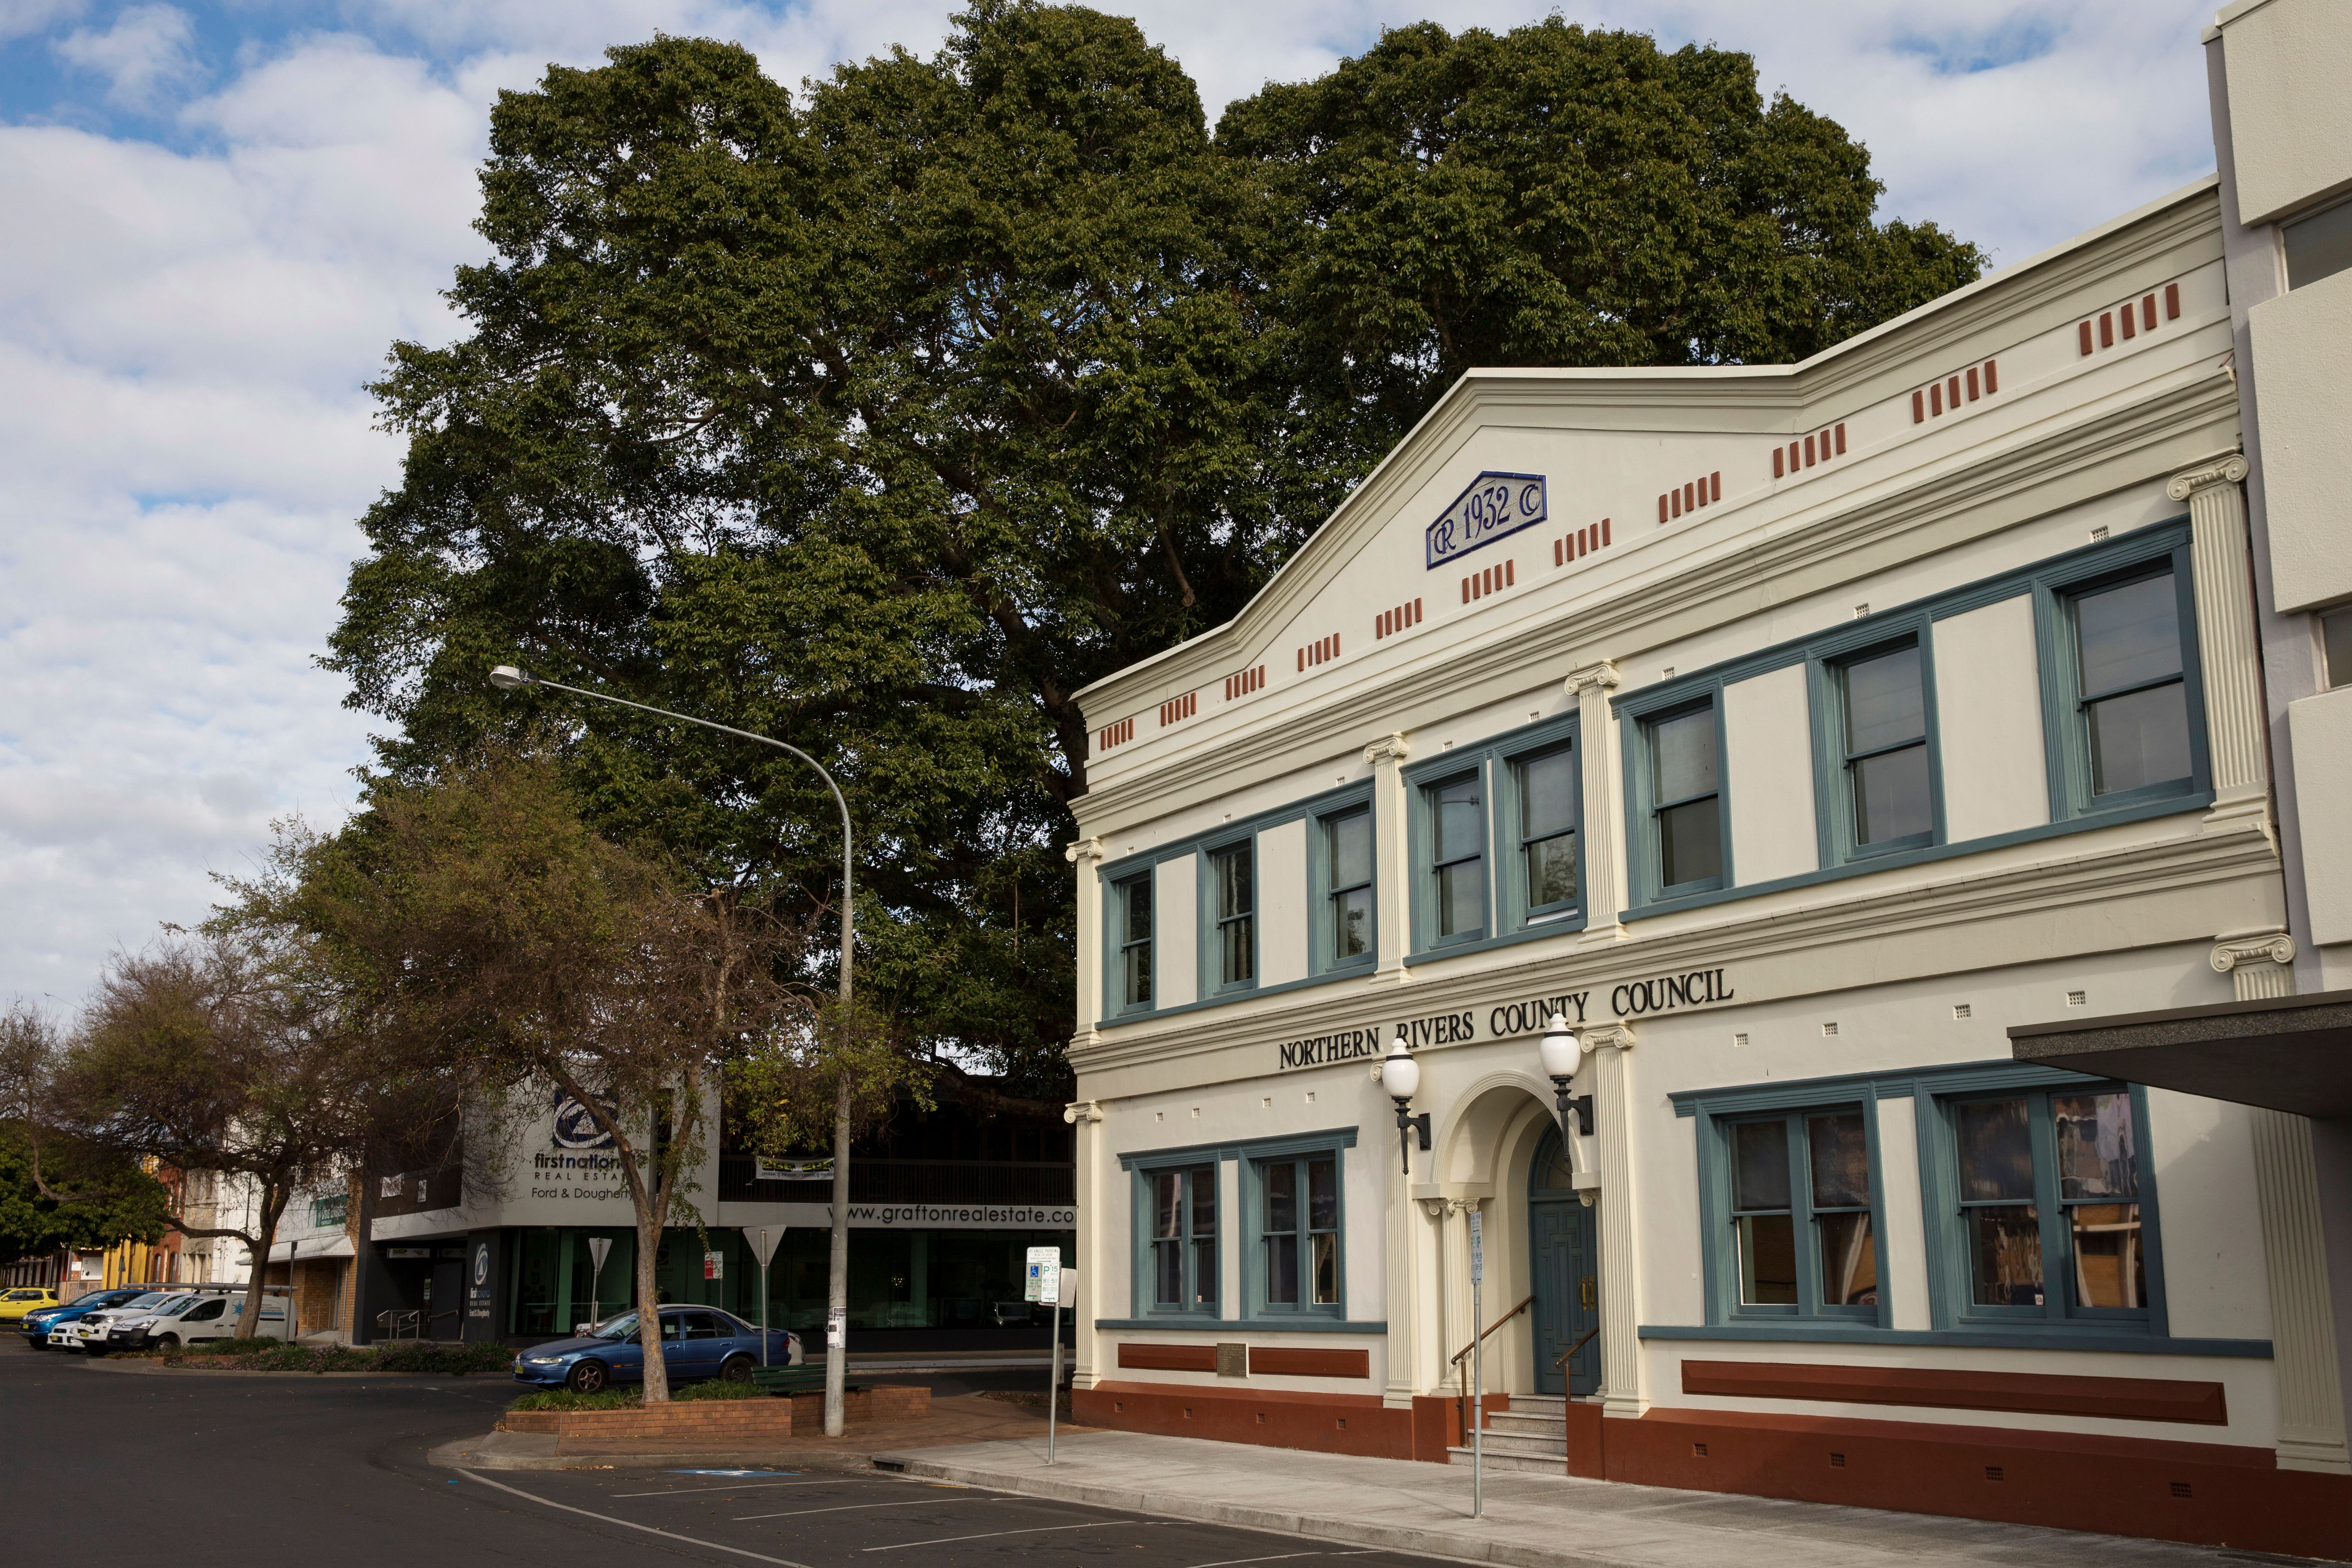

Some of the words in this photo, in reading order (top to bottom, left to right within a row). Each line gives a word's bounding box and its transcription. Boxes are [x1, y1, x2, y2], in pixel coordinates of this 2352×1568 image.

[1464, 486, 1511, 540] 1932
[1279, 1027, 1380, 1069] NORTHERN
[1396, 1011, 1474, 1049] RIVERS
[1490, 991, 1589, 1036] COUNTY
[1612, 968, 1735, 1016] COUNCIL
[532, 1187, 557, 1198] Ford
[561, 1188, 569, 1198] &
[574, 1188, 632, 1201] Dougherty
[828, 1205, 1077, 1224] ww.graftonrealestate.co
[1044, 1266, 1050, 1275] P
